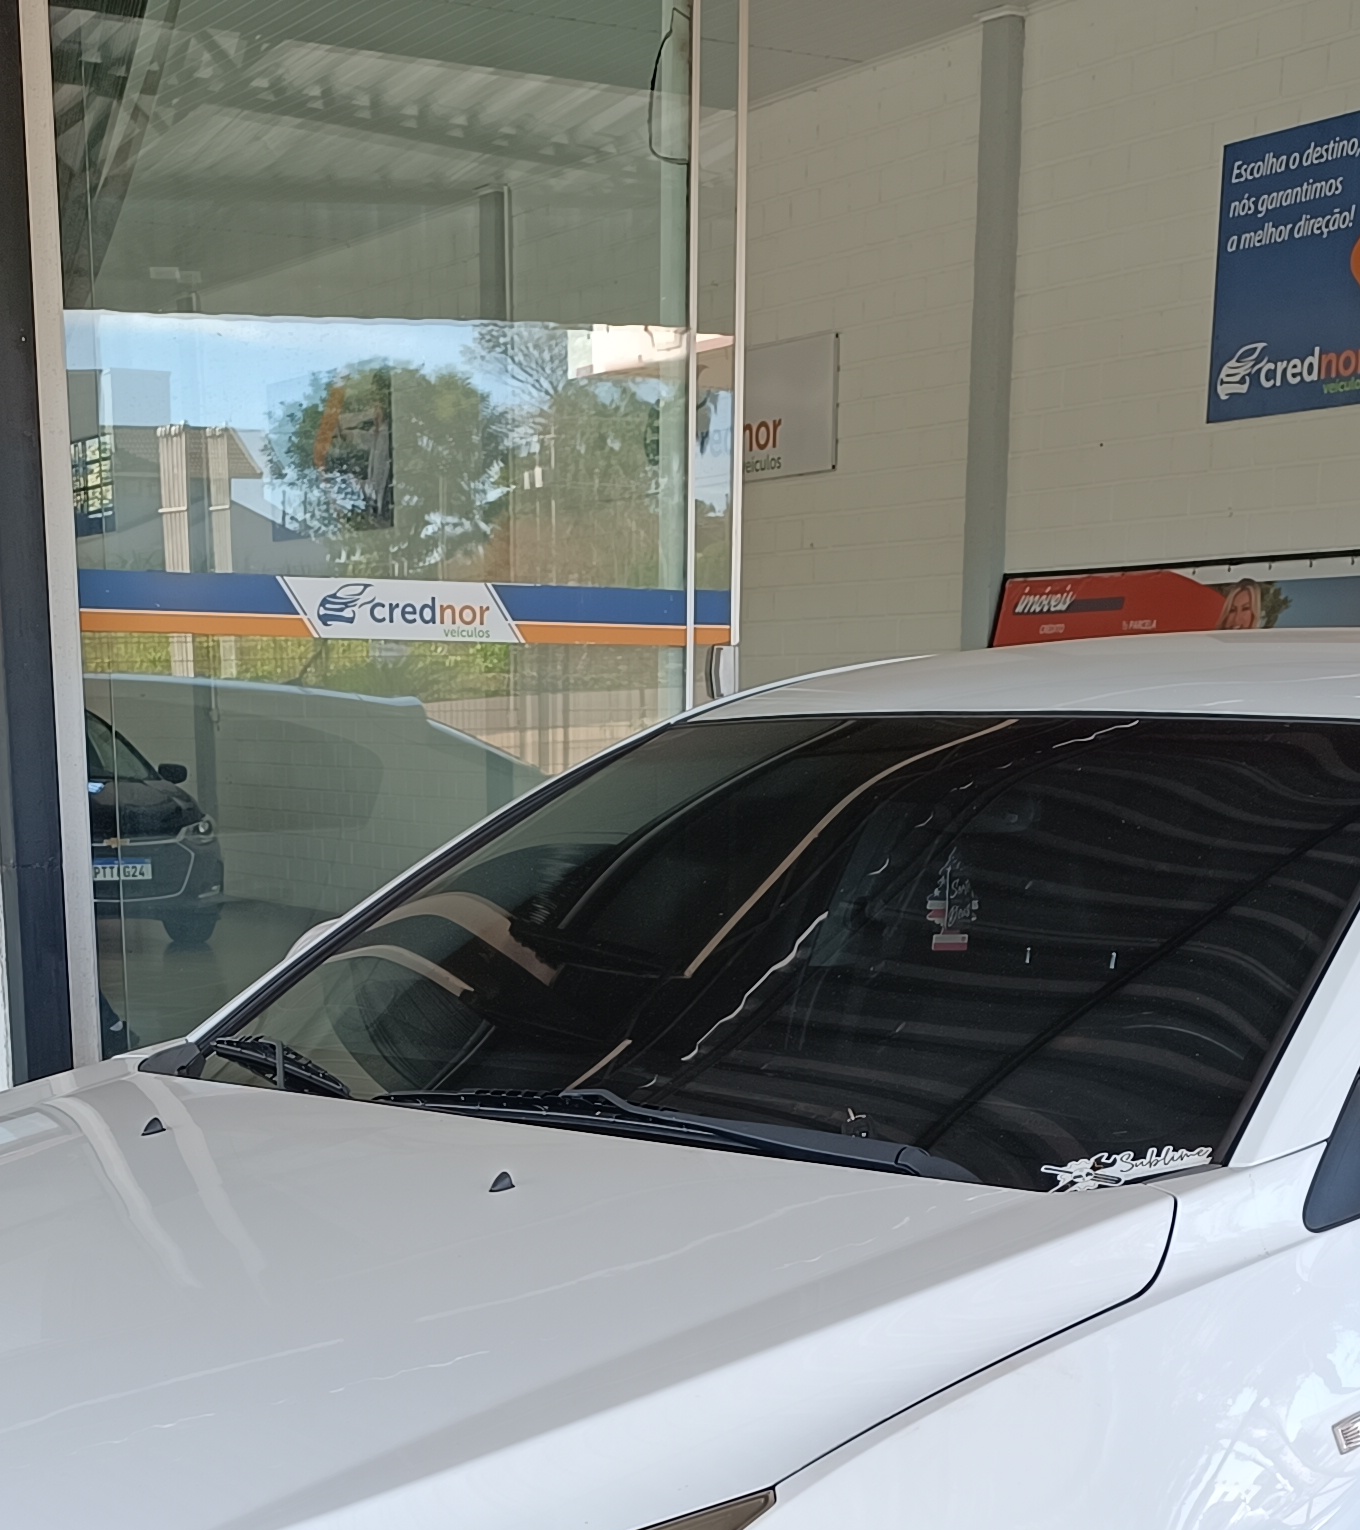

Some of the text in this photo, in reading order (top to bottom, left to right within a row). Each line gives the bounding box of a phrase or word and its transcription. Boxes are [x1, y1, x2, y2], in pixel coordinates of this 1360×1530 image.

[1231, 137, 1360, 184] Escolha o destino,
[1229, 176, 1344, 218] nós garantimos
[1227, 204, 1356, 253] a melhor direção!
[744, 454, 782, 474] eículos
[369, 596, 490, 626] crednor
[443, 627, 491, 639] veículos
[1119, 1147, 1210, 1173] Sublime
